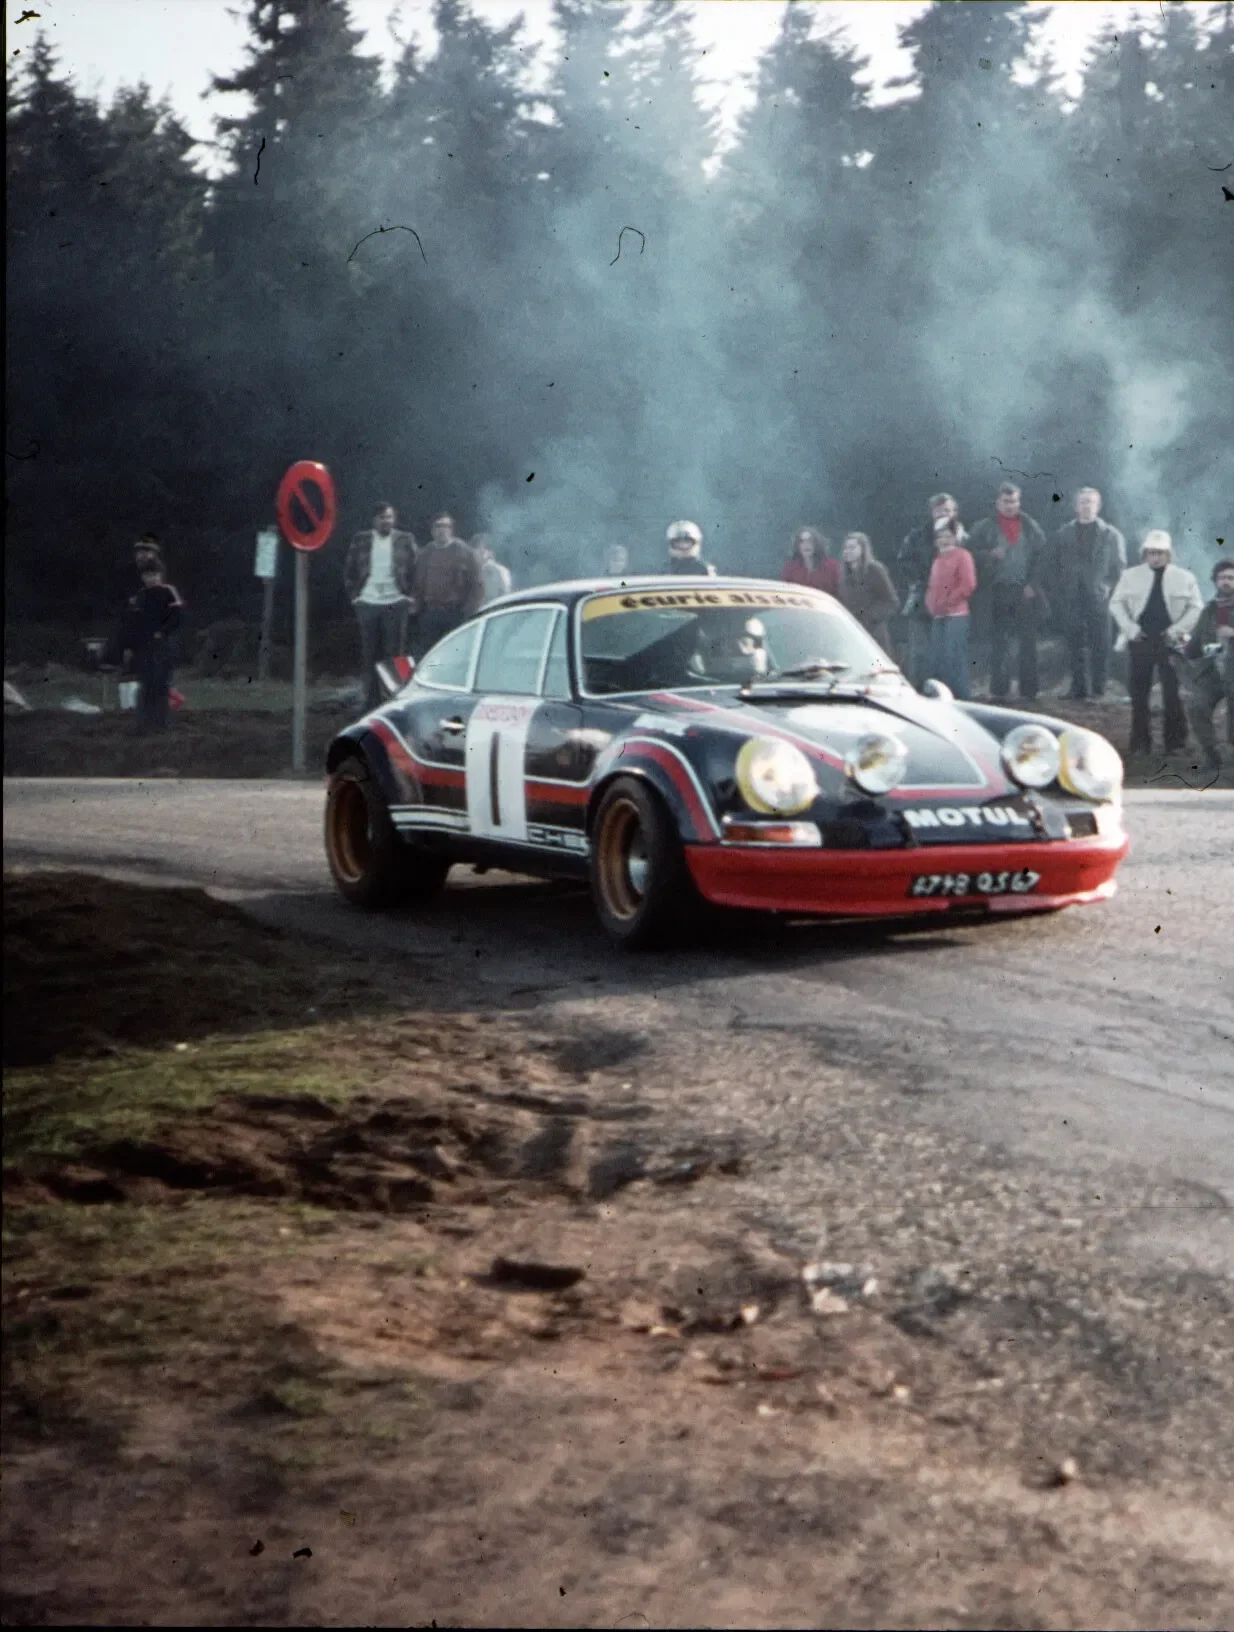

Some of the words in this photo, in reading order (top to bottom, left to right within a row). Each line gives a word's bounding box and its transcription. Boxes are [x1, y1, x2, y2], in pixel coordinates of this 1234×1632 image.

[620, 593, 719, 608] écurie
[730, 593, 814, 608] alsace
[903, 807, 1029, 828] MOTUL
